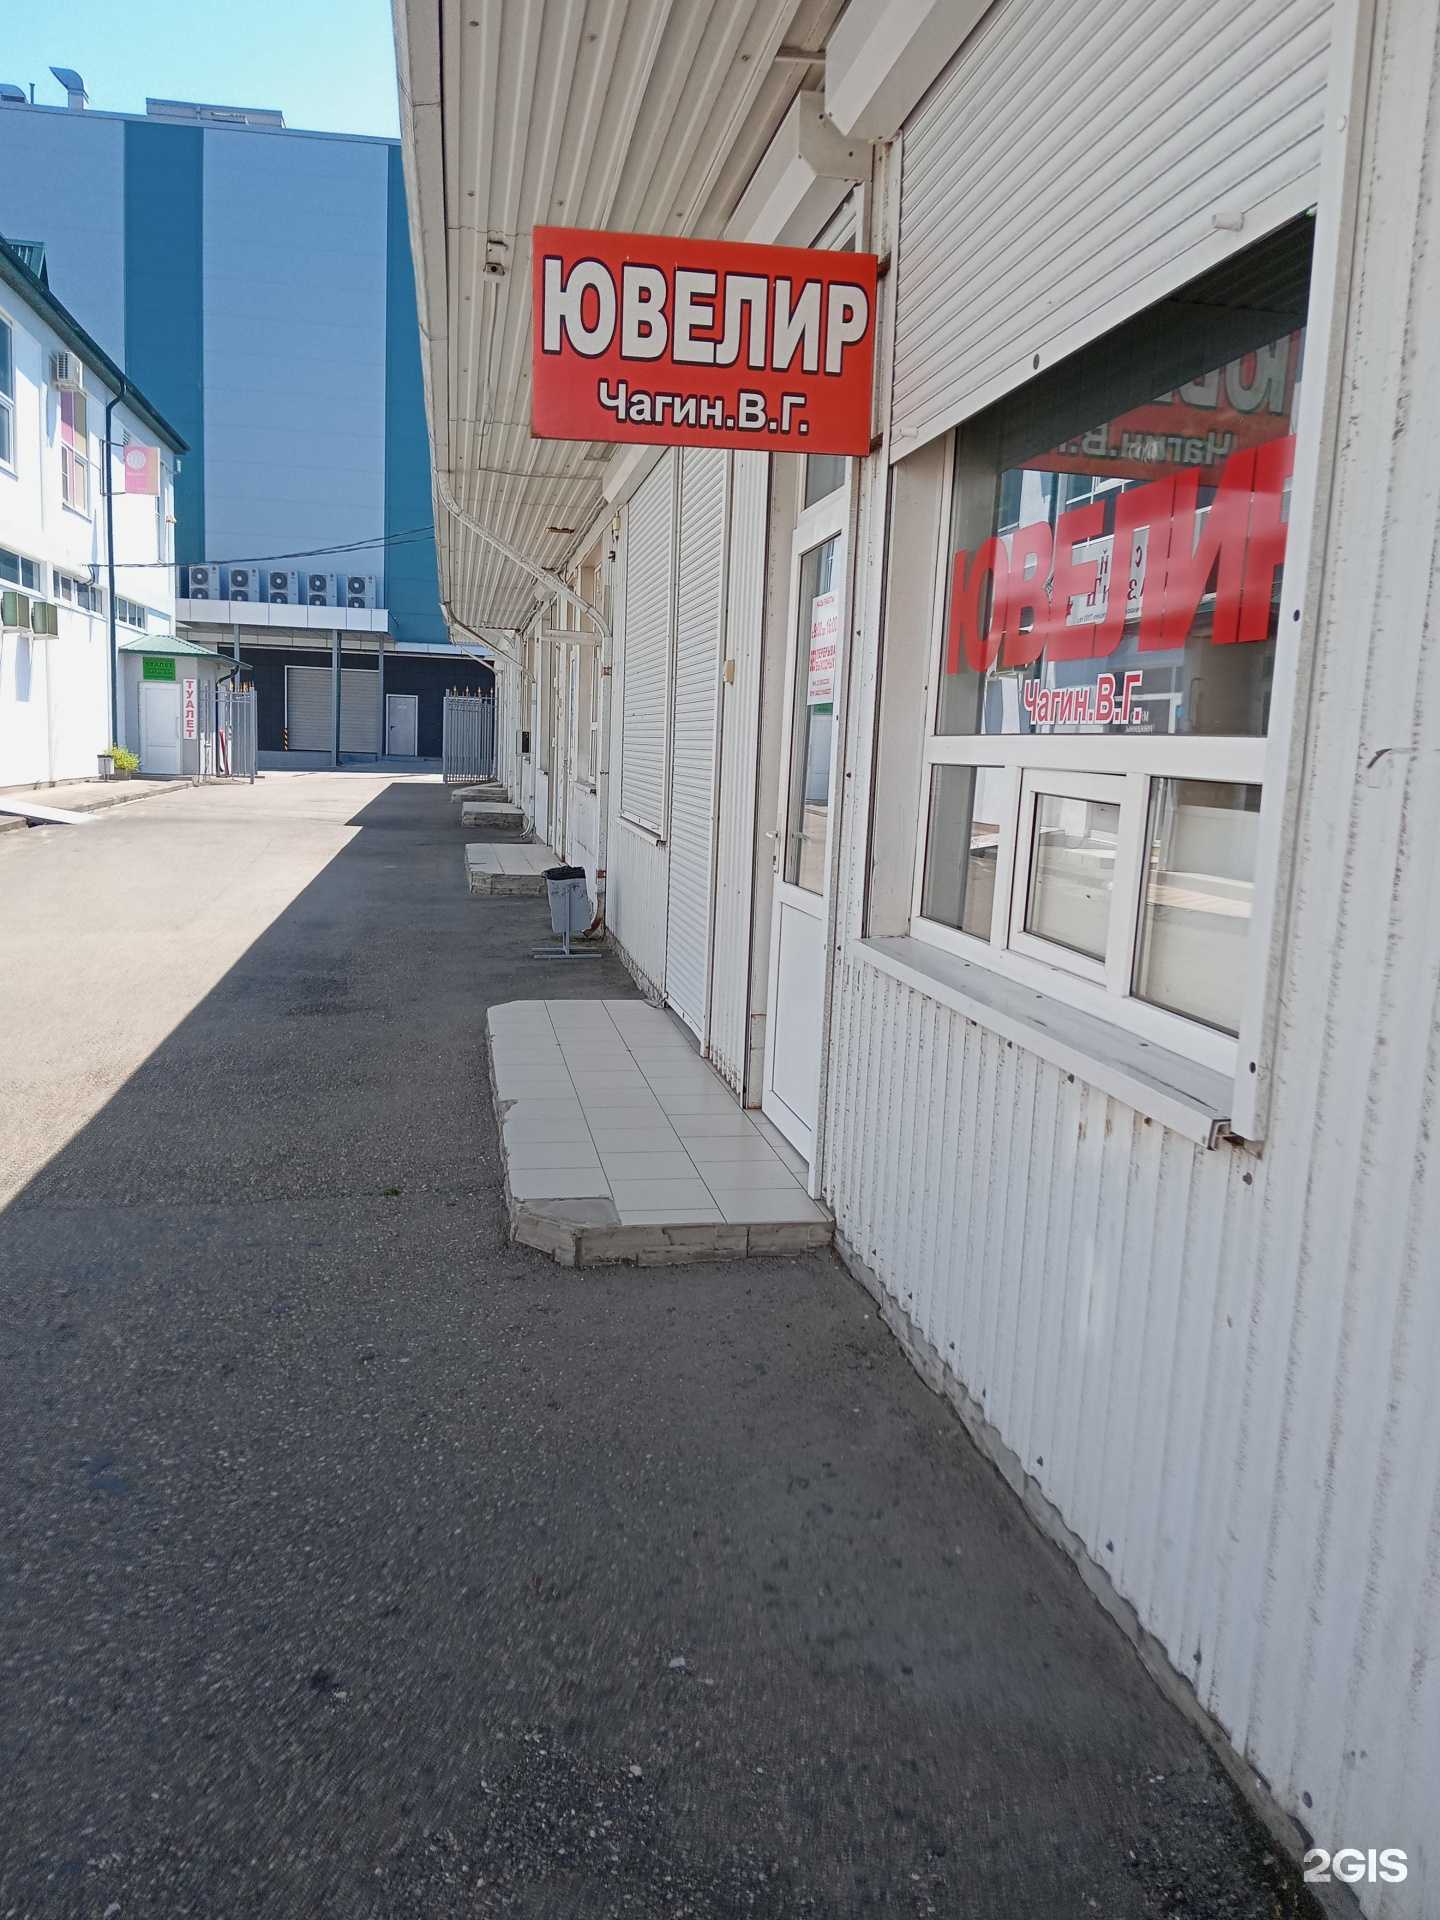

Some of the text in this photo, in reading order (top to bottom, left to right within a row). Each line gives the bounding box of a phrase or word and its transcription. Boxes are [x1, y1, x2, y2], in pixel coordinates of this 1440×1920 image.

[543, 255, 870, 376] ЮВЕЛИР
[598, 378, 810, 435] Чагин.В.Г.
[185, 680, 195, 738] ТУАЛЕТ
[1024, 670, 1143, 725] Чагин.В.Г.
